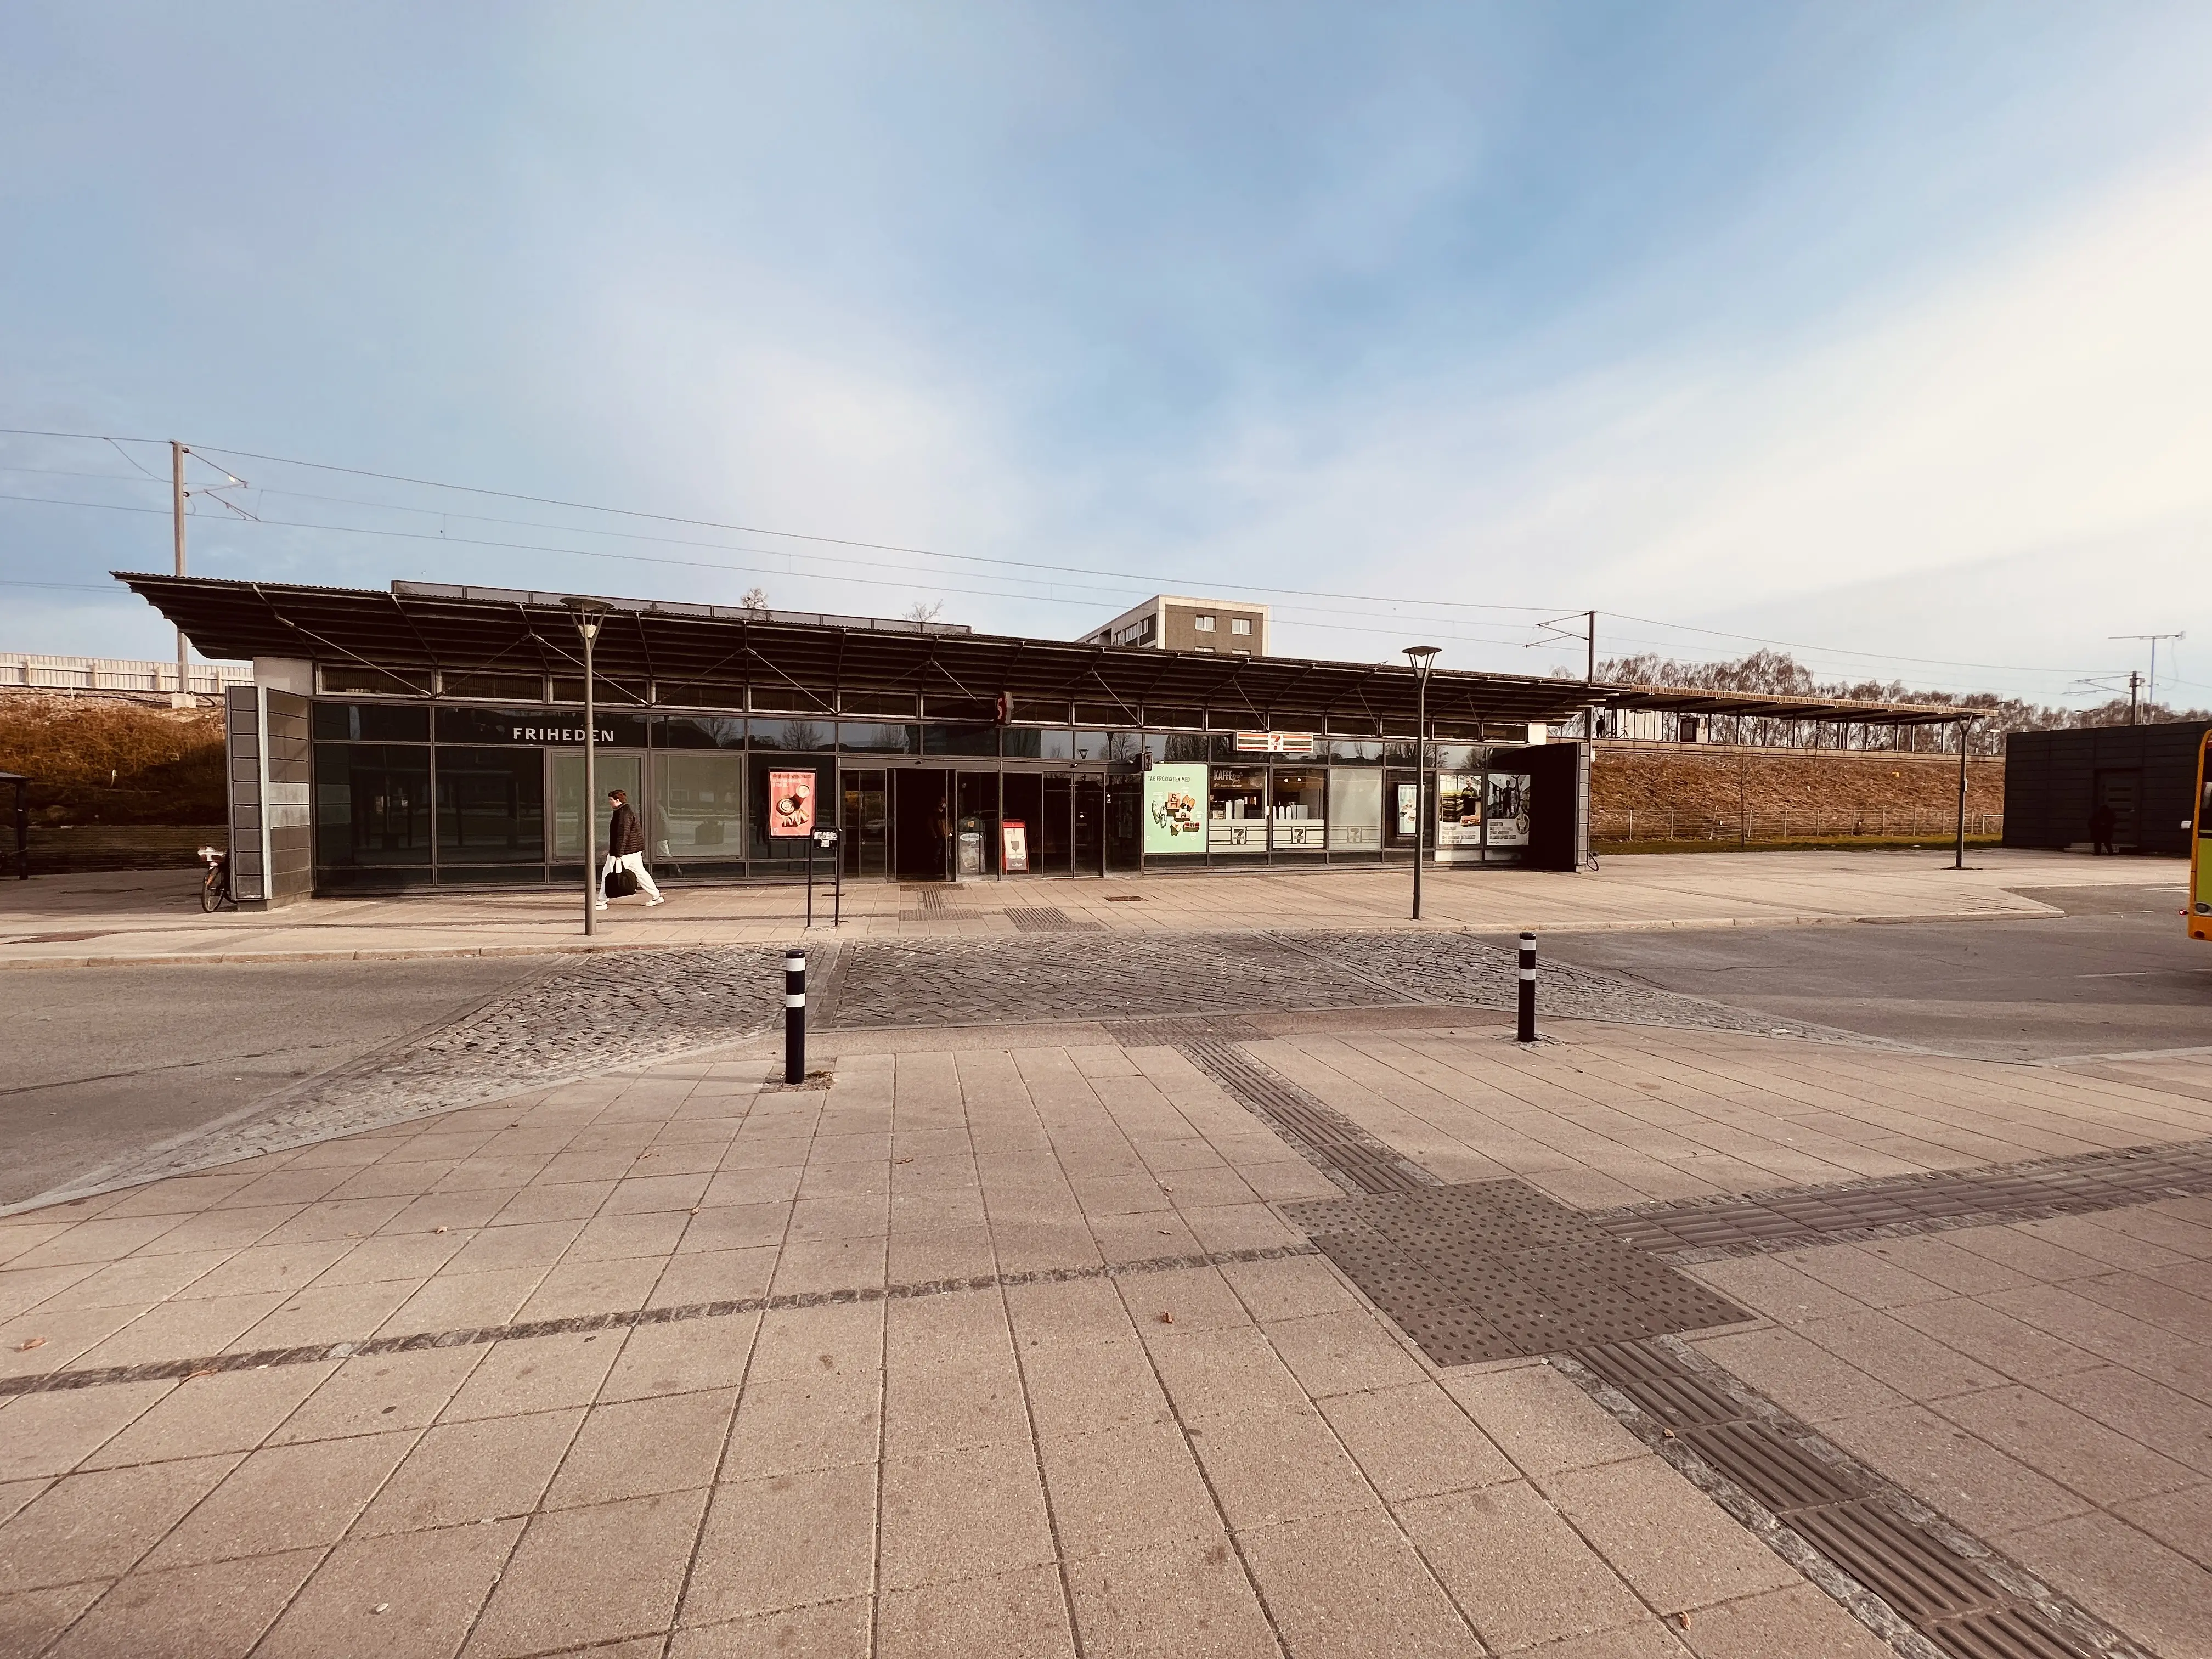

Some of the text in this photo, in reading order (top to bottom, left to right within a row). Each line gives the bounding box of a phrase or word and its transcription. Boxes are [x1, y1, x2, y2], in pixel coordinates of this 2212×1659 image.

[514, 727, 613, 741] FRIHEDEN
[1271, 735, 1280, 750] 7
[1214, 770, 1232, 780] KAFFE
[1234, 829, 1244, 844] 7
[1294, 829, 1304, 844] 7
[1350, 828, 1359, 843] 7
